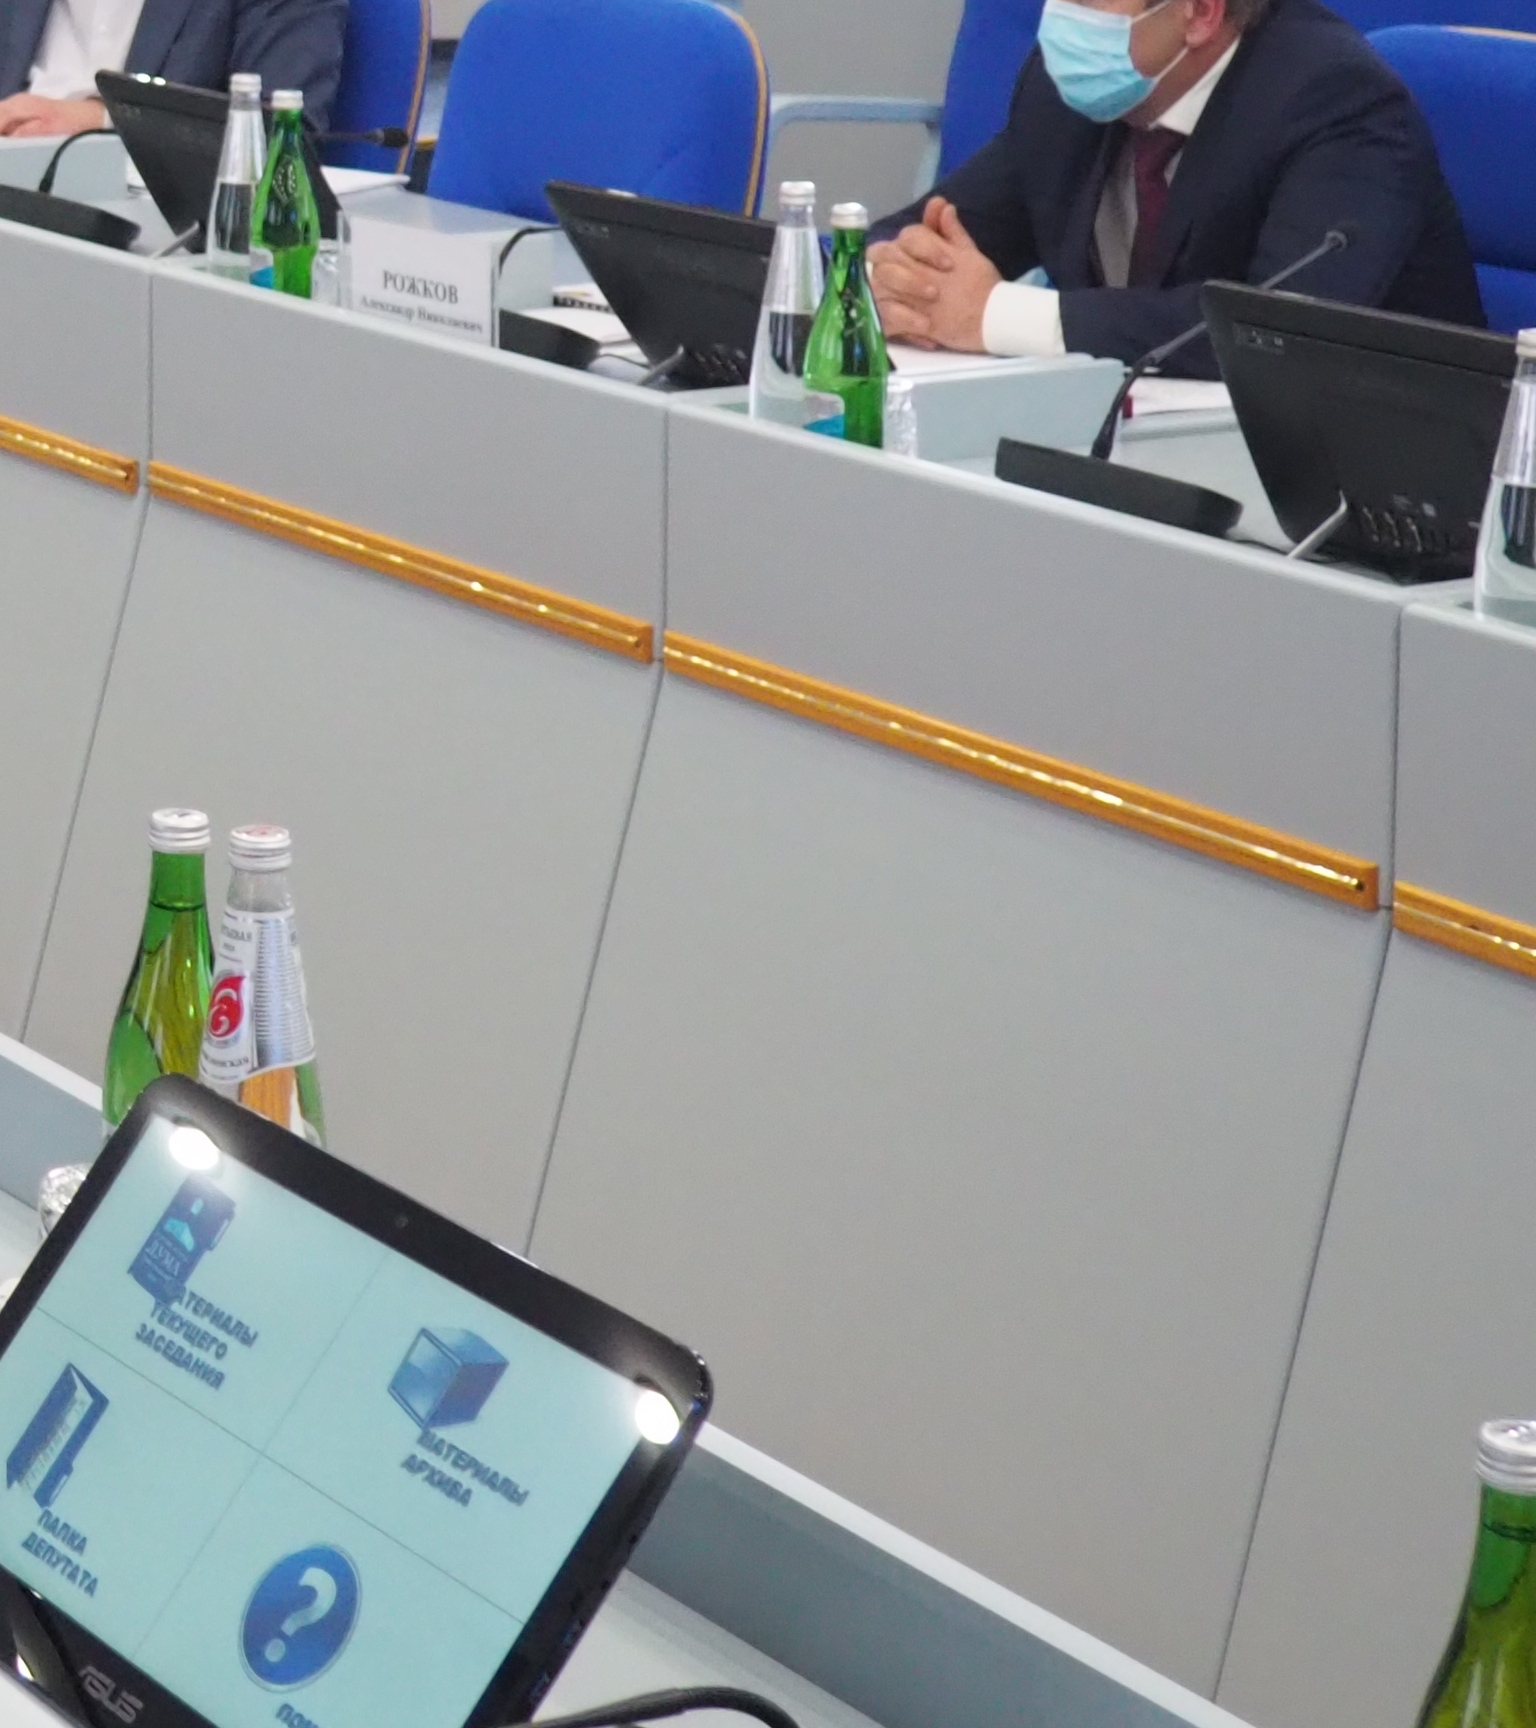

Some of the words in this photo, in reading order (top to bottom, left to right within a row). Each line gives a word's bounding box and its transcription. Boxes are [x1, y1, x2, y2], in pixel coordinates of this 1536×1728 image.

[383, 270, 459, 304] РОЖКОВ
[150, 1296, 228, 1361] ТЕКУЩЕГО
[169, 1284, 259, 1349] АТЕРИАЛЫ
[135, 1322, 226, 1391] ЗАСЕДАНИЯ
[401, 1453, 473, 1508] АРХИВА
[416, 1429, 530, 1507] МАТЕРИАЛЫ
[21, 1531, 99, 1598] ДЕПУТАТА
[37, 1508, 88, 1557] ПАПКА
[79, 1665, 145, 1724] ASUS
